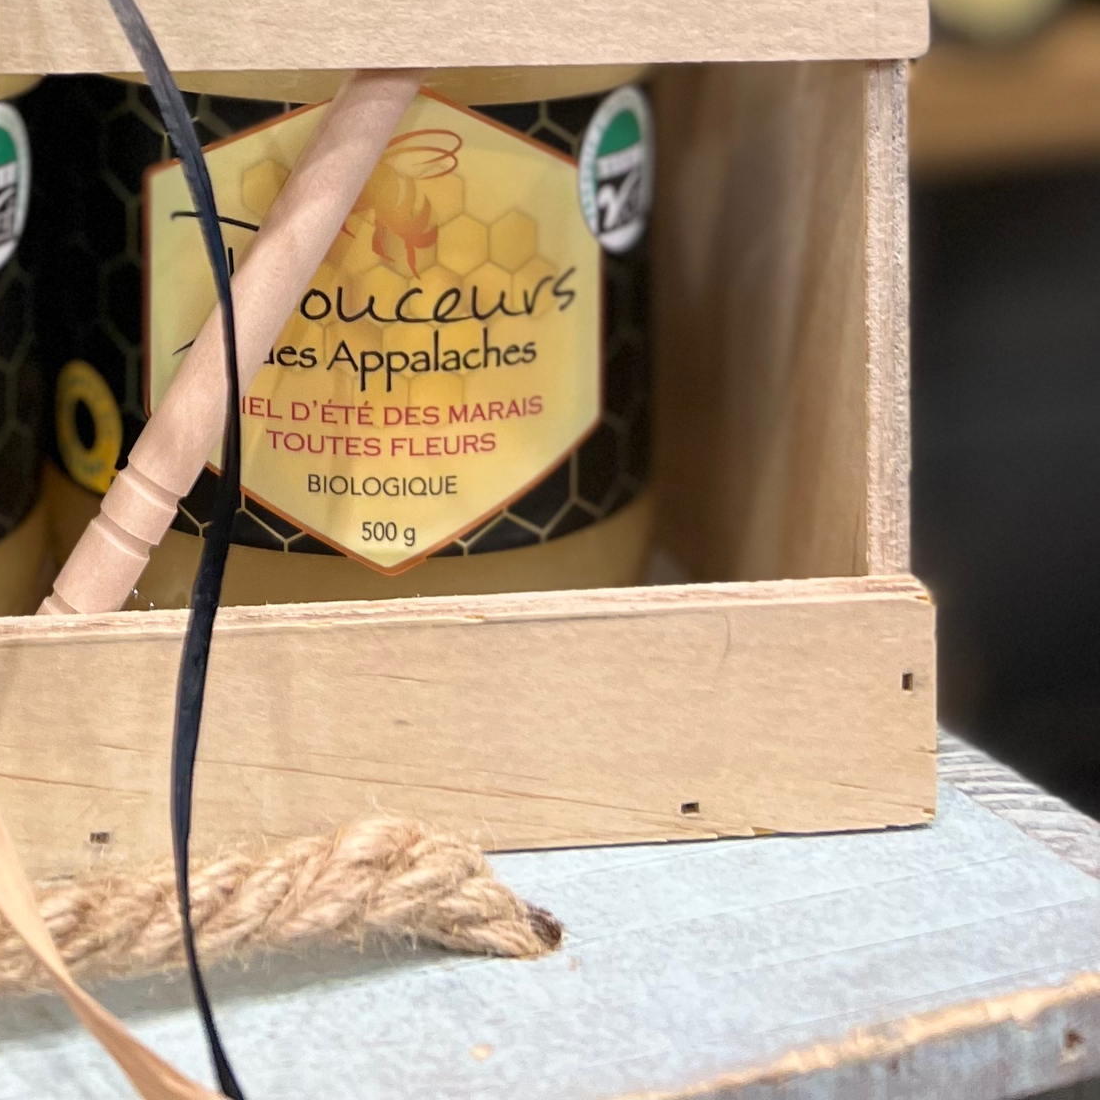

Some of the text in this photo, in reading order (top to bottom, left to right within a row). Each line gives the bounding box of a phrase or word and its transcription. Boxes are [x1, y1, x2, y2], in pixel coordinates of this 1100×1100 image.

[326, 327, 538, 392] Appalaches
[241, 394, 543, 427] IEL D'ÉTÉ DES MARAIS
[266, 429, 497, 457] TOUTES FLEURS
[307, 474, 458, 497] BIOLOGIQUE
[361, 521, 417, 547] 500 g
